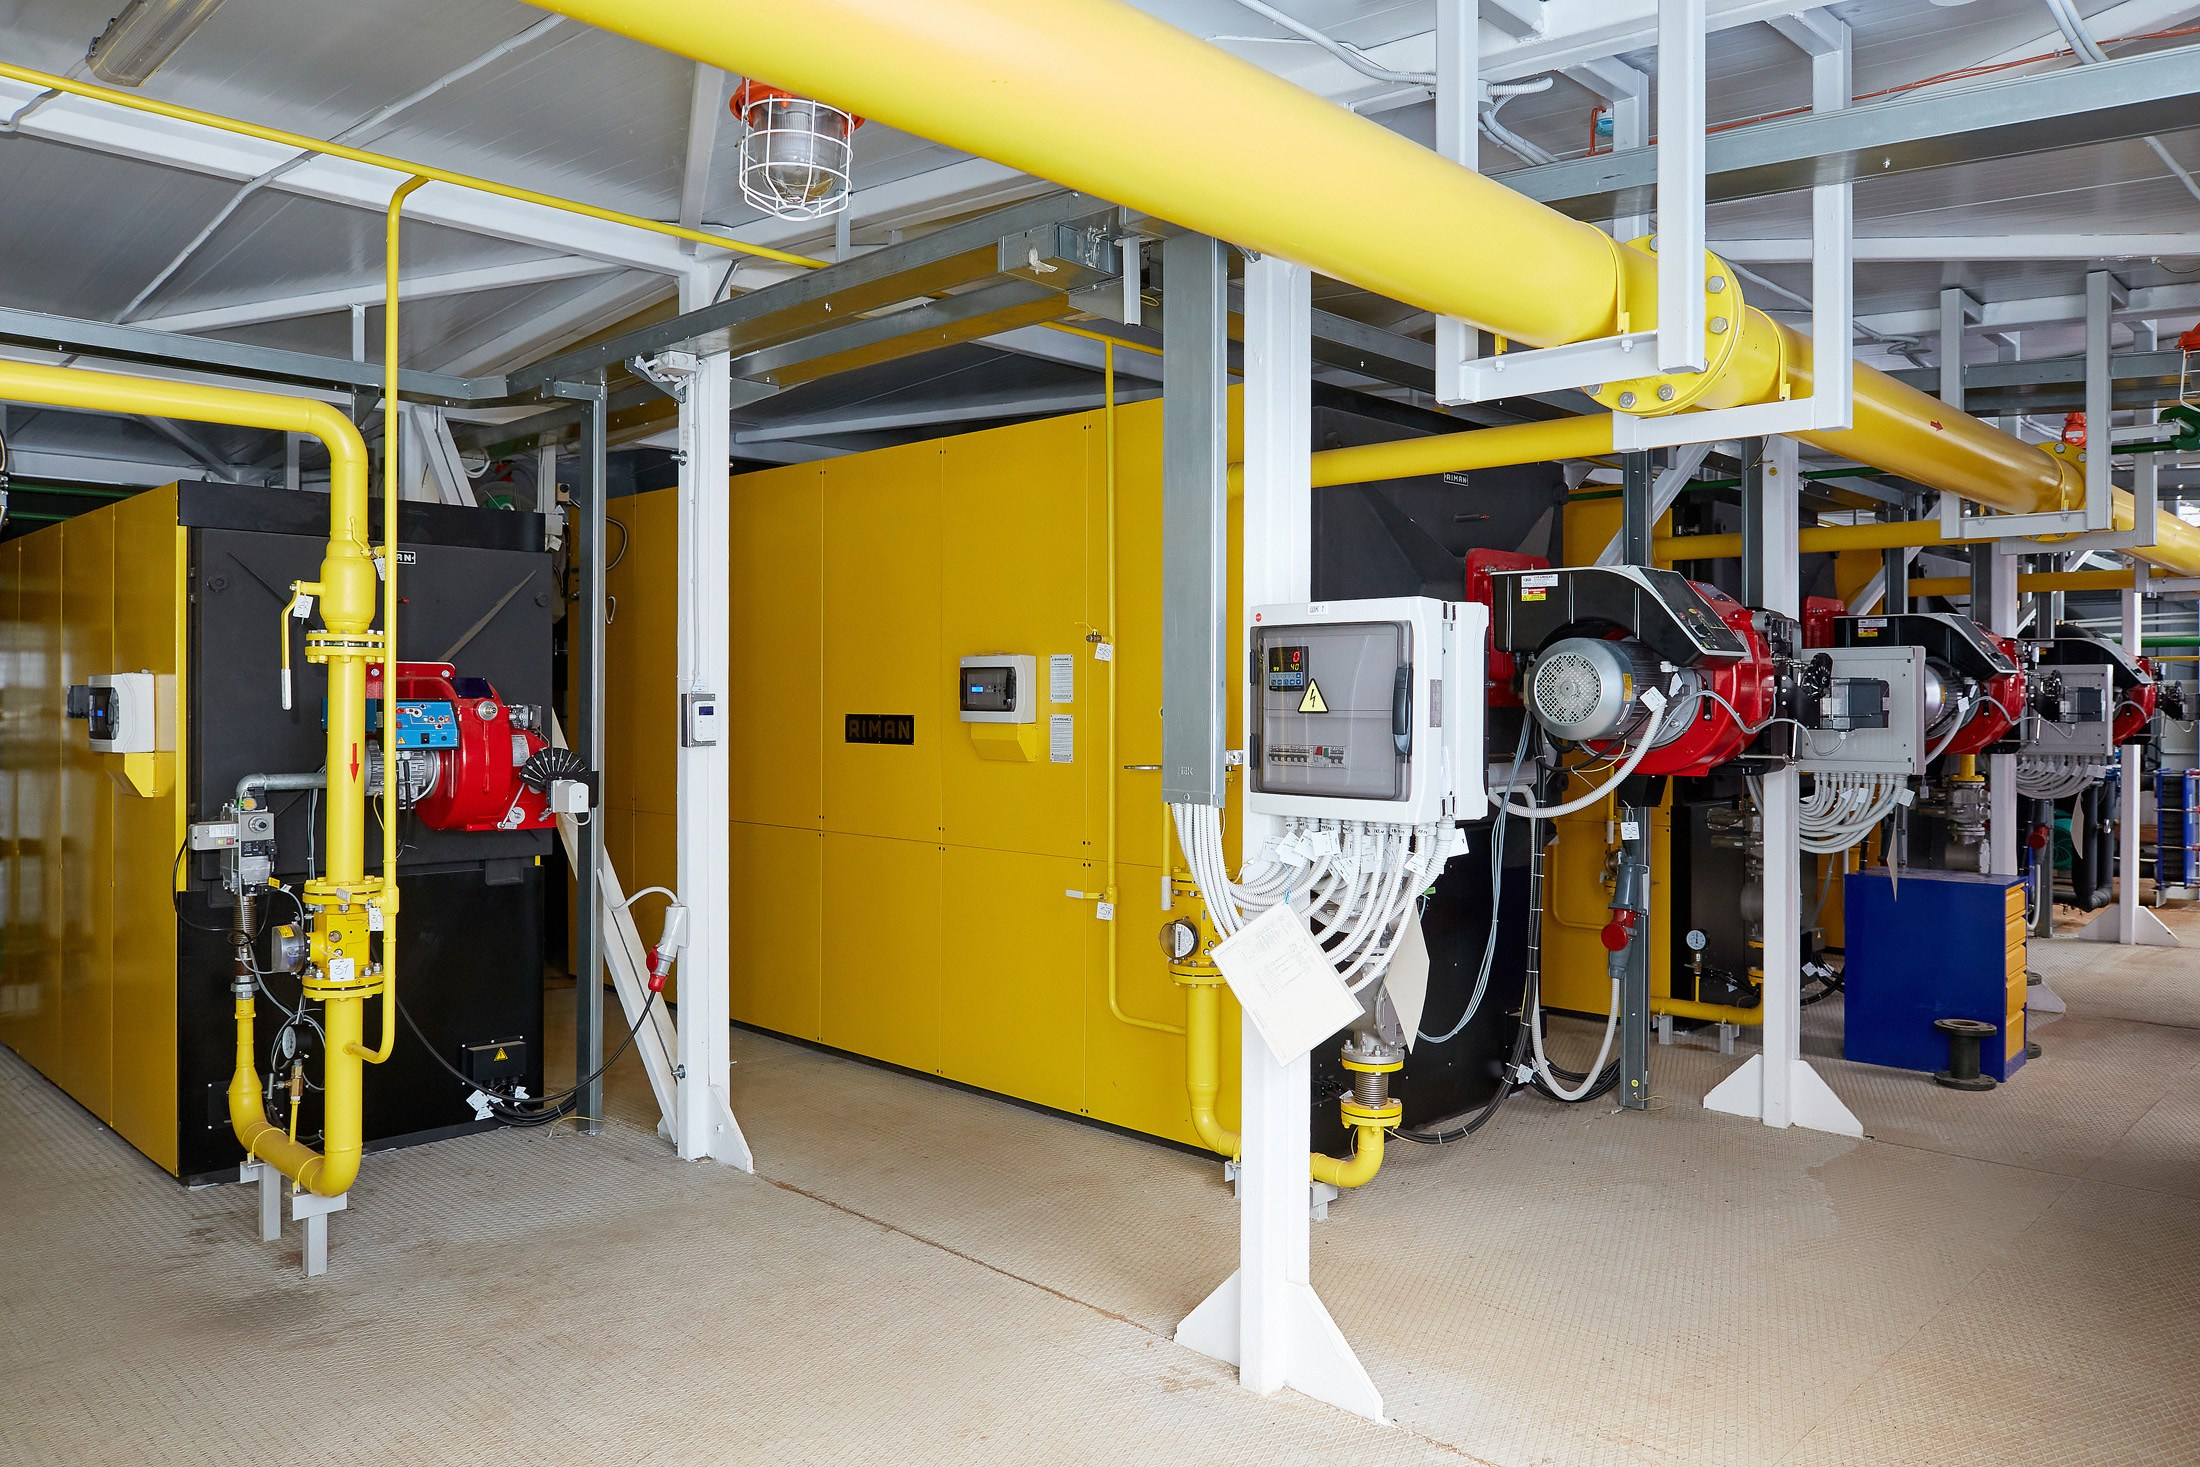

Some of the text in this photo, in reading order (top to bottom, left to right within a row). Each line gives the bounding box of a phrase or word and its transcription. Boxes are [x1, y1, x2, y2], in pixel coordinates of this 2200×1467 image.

[1446, 473, 1467, 484] RIMAN
[1292, 650, 1301, 663] 0
[1290, 663, 1300, 671] 40
[848, 719, 911, 740] RIMAN
